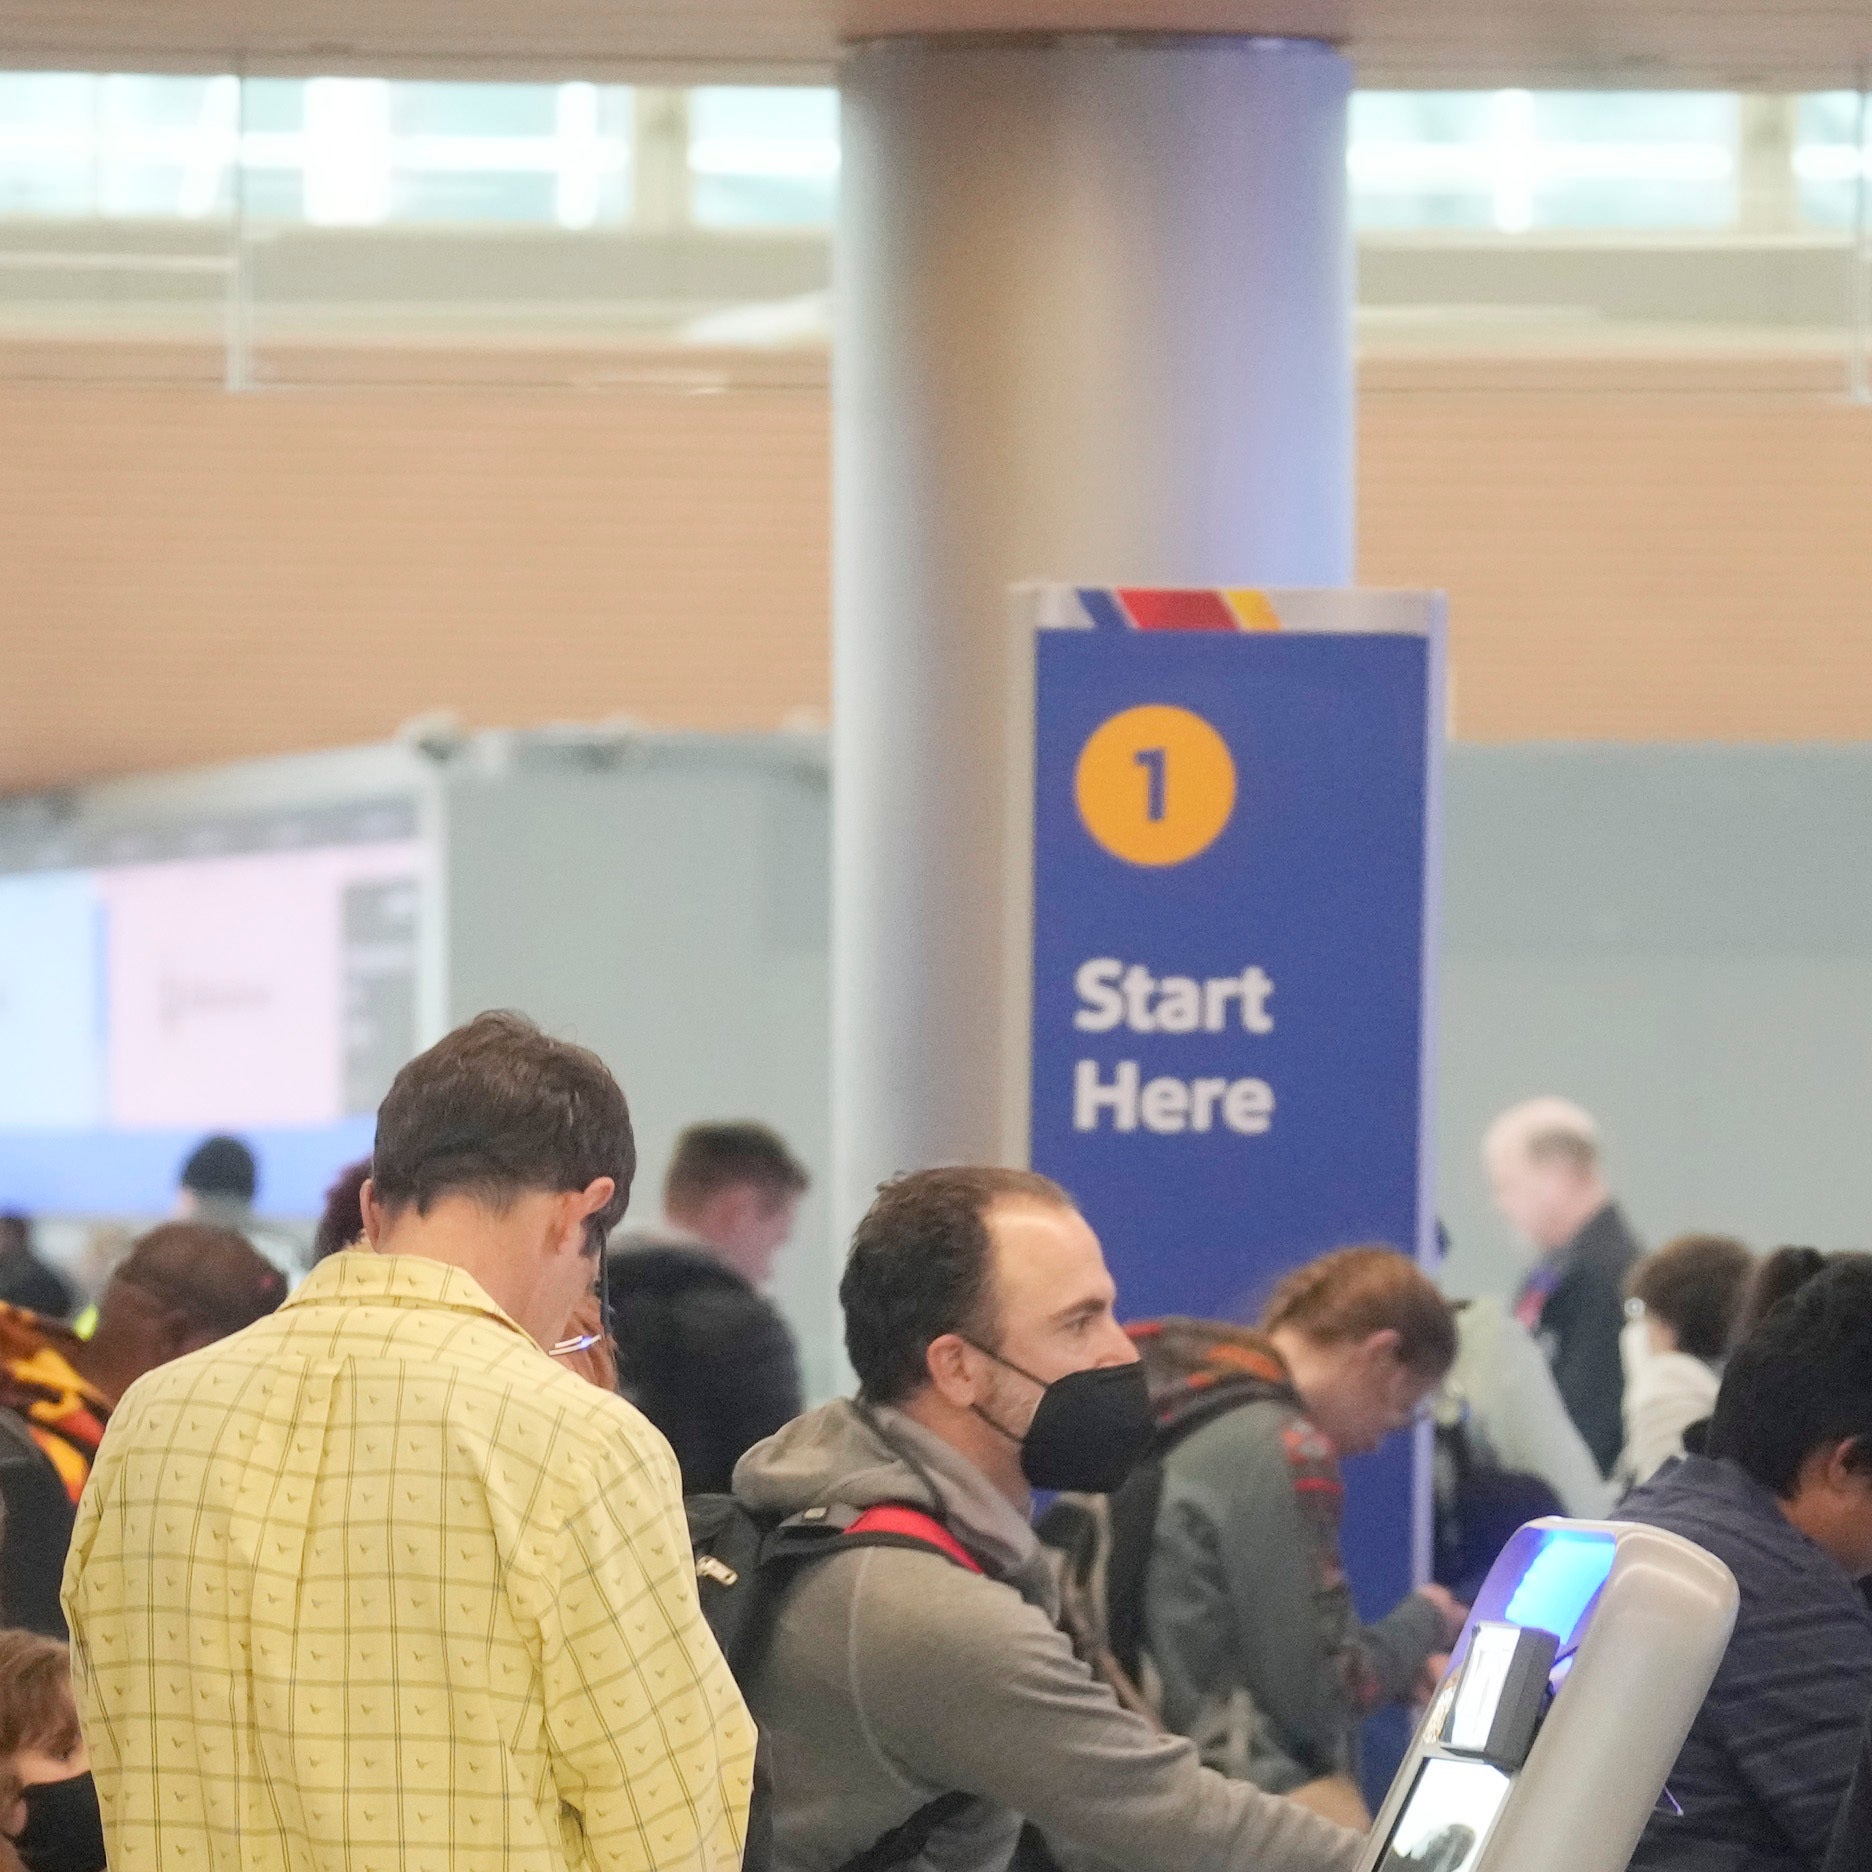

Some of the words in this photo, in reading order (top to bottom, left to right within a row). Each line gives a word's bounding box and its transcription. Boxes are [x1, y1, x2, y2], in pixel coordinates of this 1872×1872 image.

[1133, 746, 1167, 822] 1
[1073, 957, 1275, 1036] Start
[1073, 1059, 1276, 1135] Here
